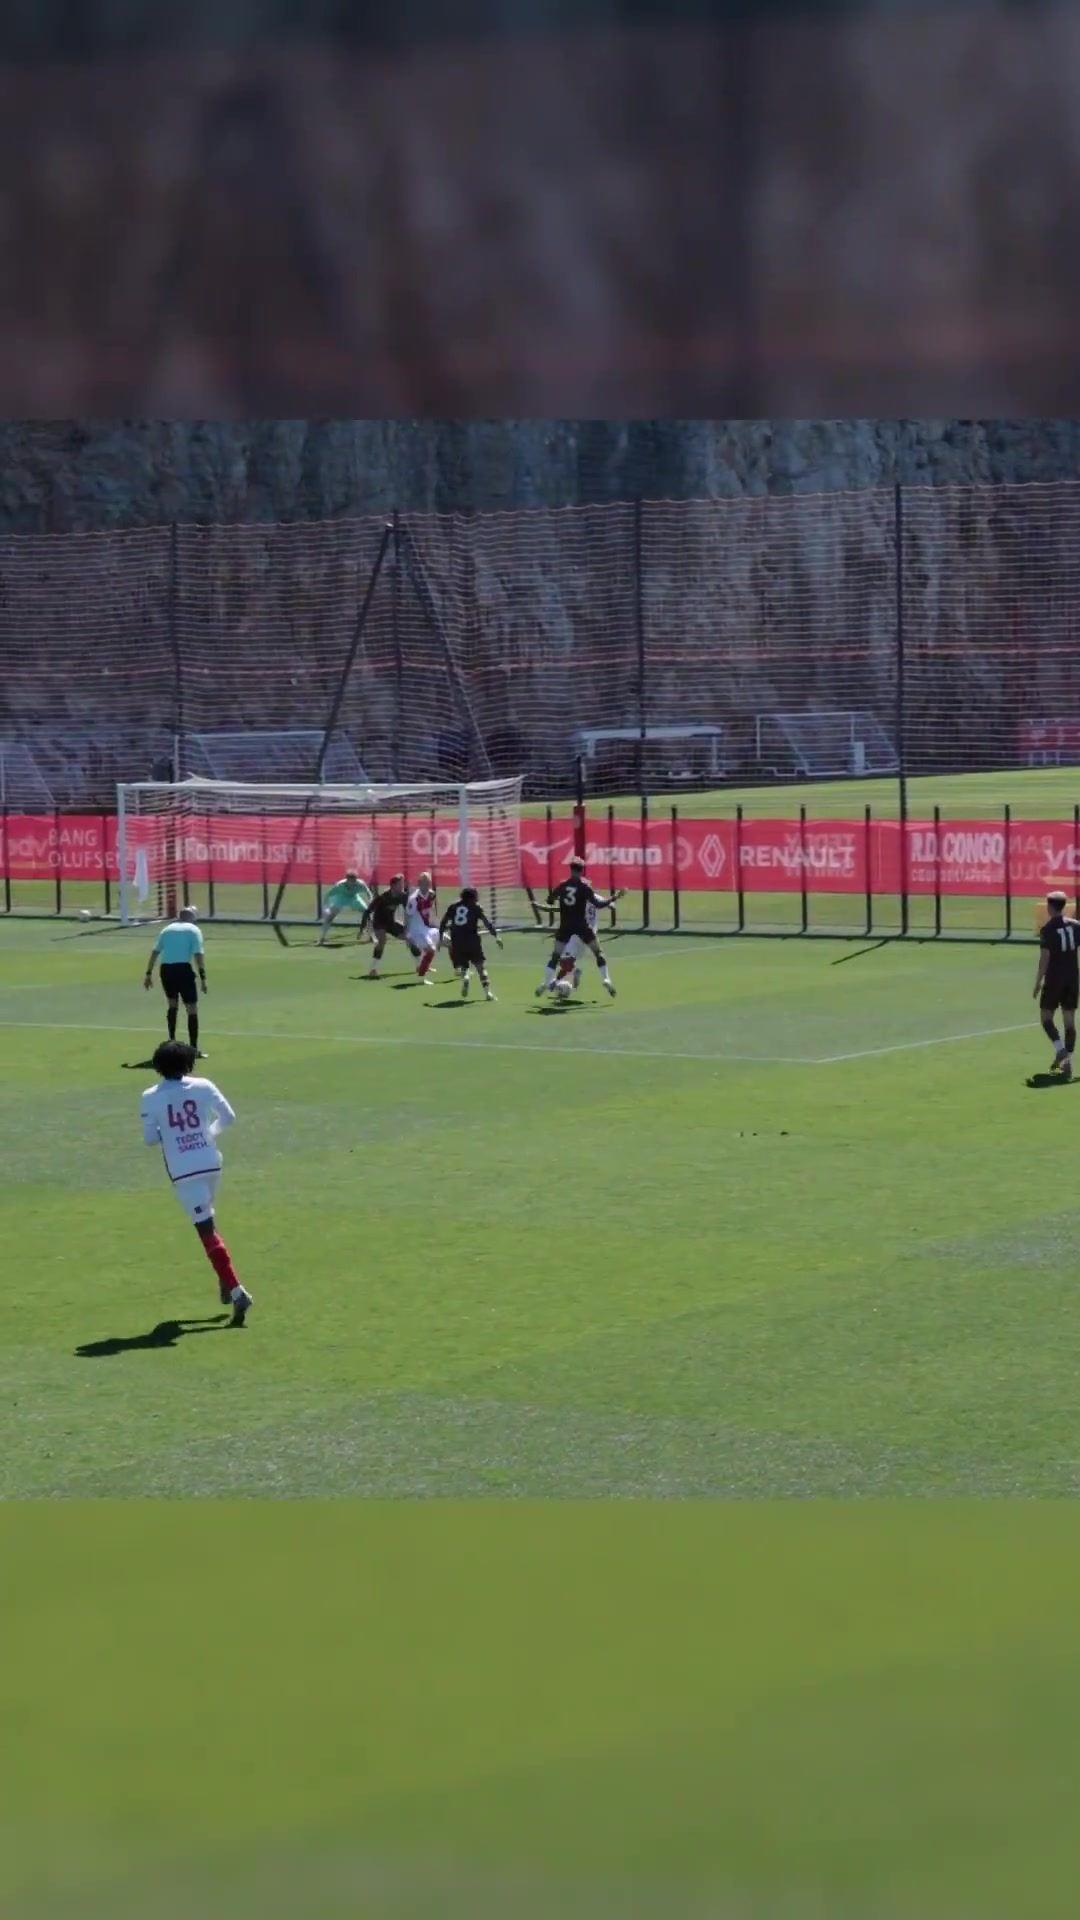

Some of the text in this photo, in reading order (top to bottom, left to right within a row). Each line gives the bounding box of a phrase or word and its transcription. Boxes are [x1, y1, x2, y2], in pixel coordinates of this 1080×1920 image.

[48, 828, 98, 847] BANG
[943, 832, 1006, 864] CONGO
[48, 850, 121, 870] OLUFSE
[739, 845, 856, 868] RENAULT
[564, 886, 578, 906] 3
[454, 905, 469, 926] 8
[1057, 926, 1076, 952] 11
[167, 1099, 201, 1132] 48
[178, 1141, 208, 1154] SMITH
